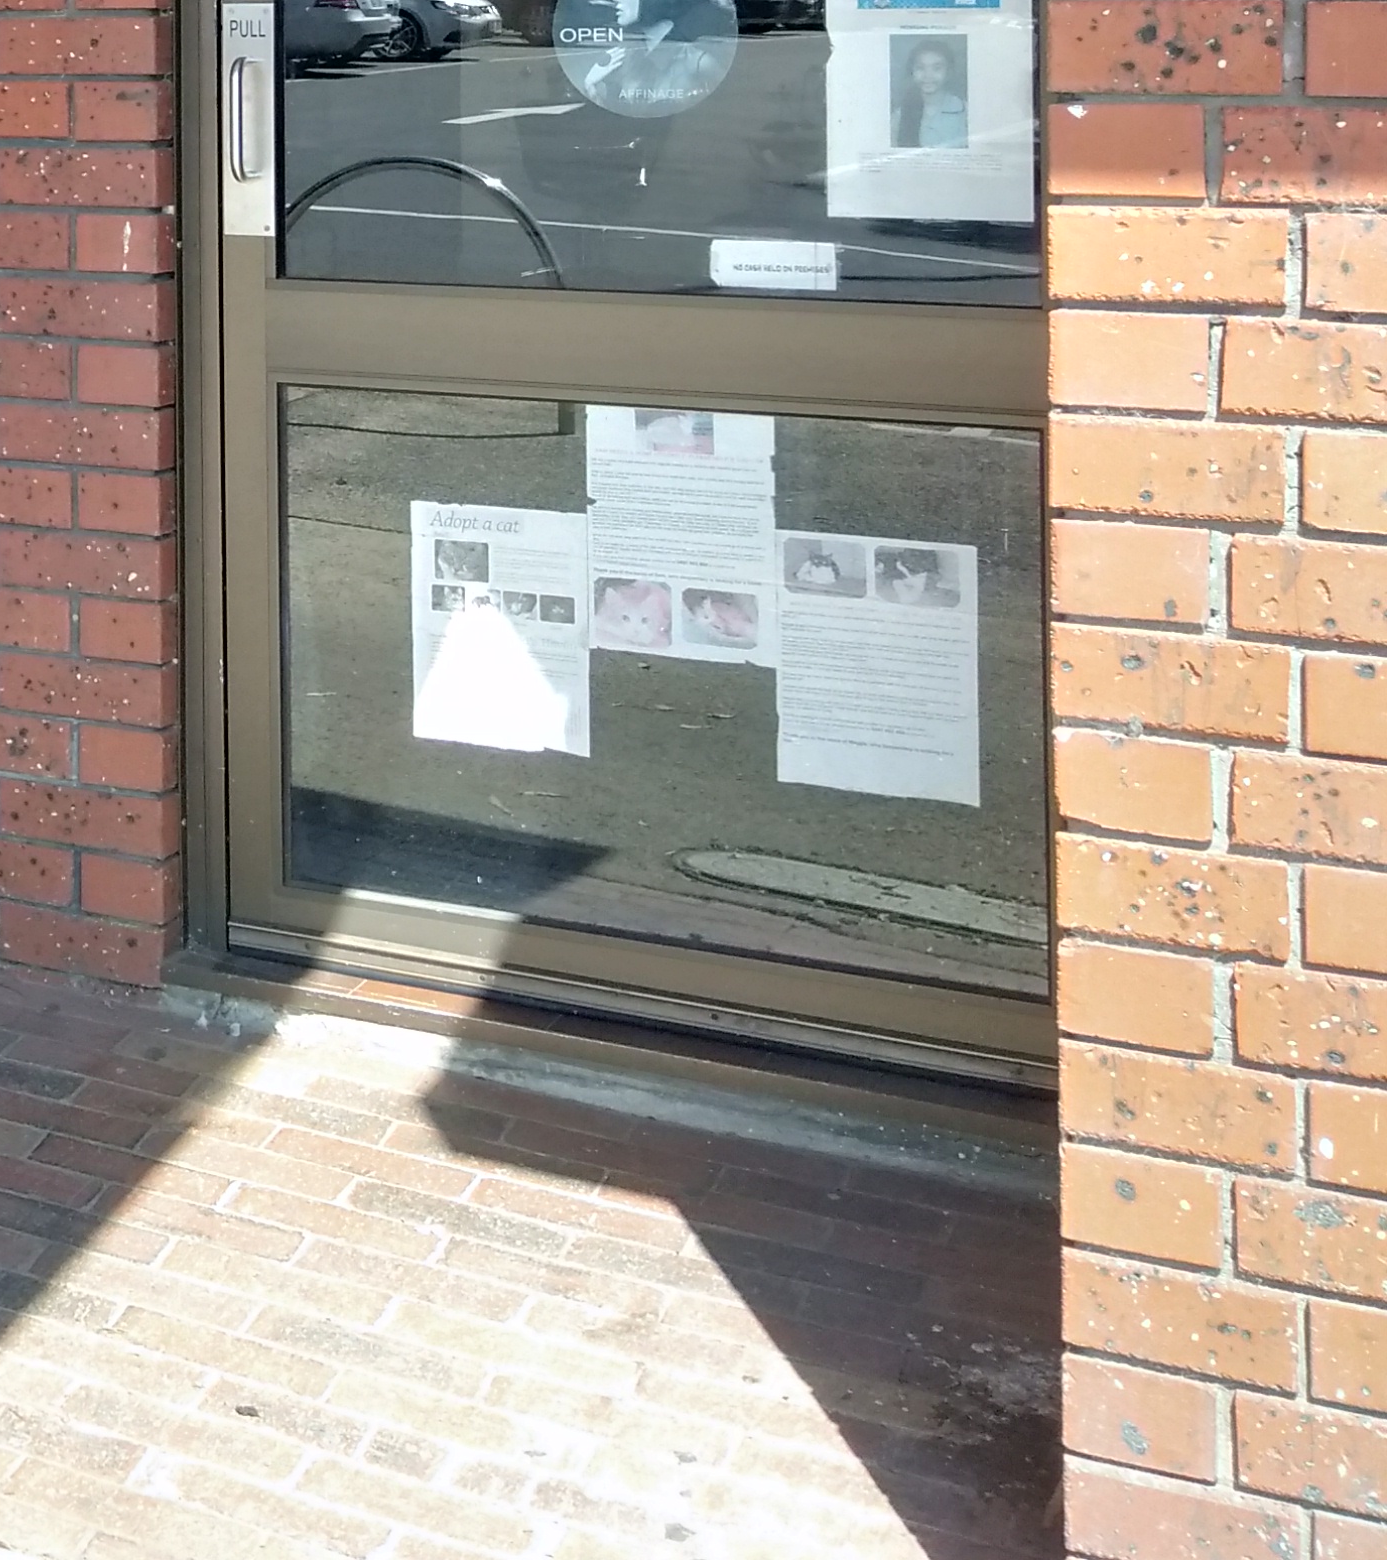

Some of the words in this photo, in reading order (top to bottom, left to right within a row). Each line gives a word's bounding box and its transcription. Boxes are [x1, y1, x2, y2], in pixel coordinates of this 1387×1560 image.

[229, 19, 266, 38] PULL
[559, 28, 624, 43] OPEN
[618, 88, 684, 100] AFFINAGE
[430, 510, 478, 534] Adopt
[482, 520, 493, 531] a
[496, 521, 520, 534] cat
